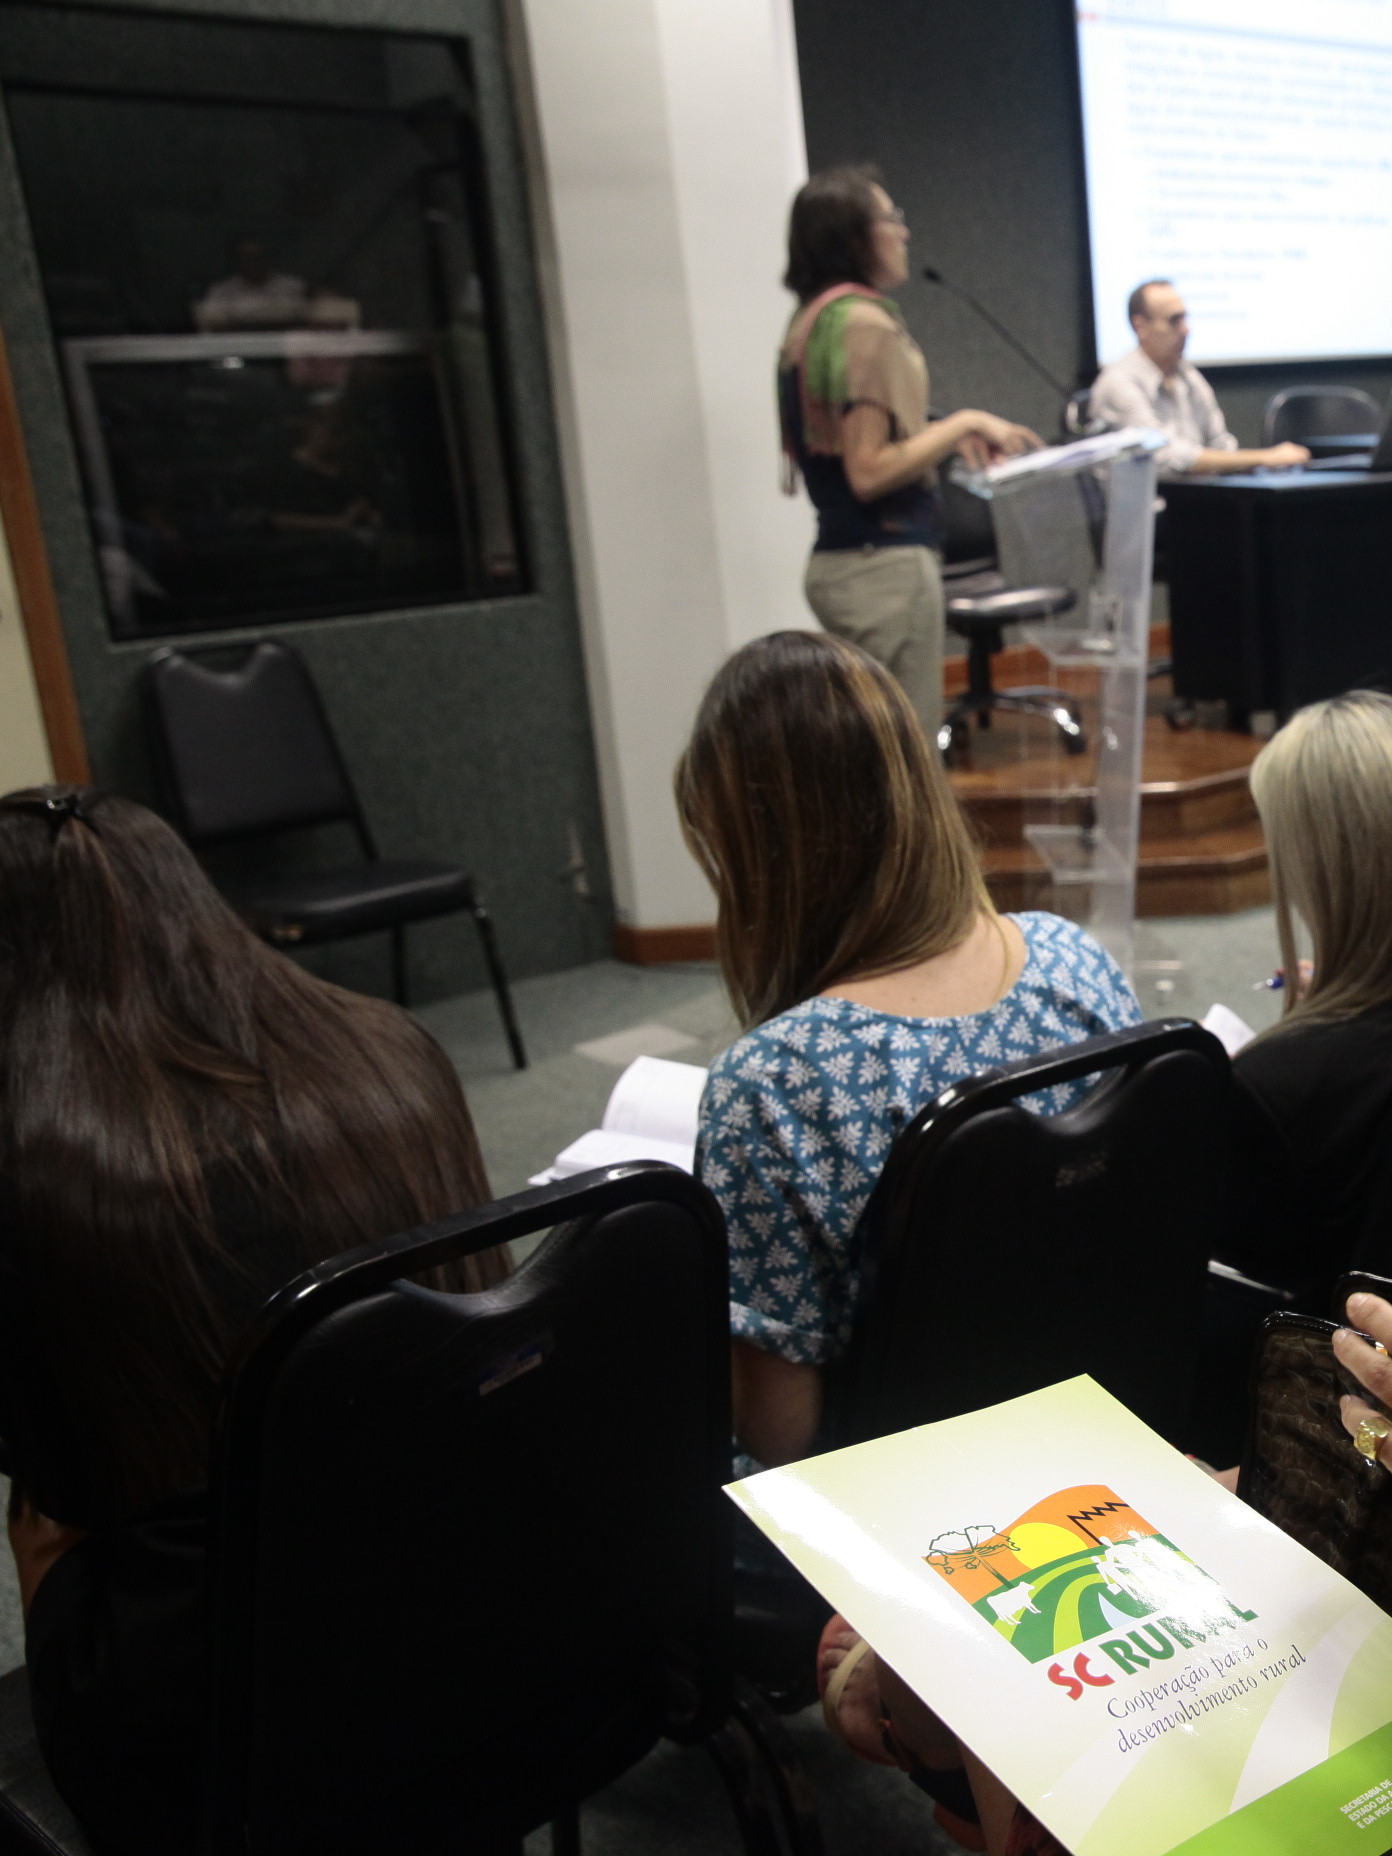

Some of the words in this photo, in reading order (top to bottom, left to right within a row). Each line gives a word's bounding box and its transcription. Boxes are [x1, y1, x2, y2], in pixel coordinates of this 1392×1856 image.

[1047, 1651, 1116, 1701] SC
[1107, 1665, 1210, 1719] Cooperação
[1210, 1643, 1255, 1678] para
[1257, 1638, 1268, 1650] o
[1117, 1674, 1258, 1753] desenvolvimento
[1260, 1644, 1306, 1681] rural
[1340, 1786, 1382, 1814] SECRETARIA
[1380, 1779, 1392, 1789] DE
[1348, 1801, 1377, 1821] ESTADO
[1375, 1794, 1389, 1804] DA
[1357, 1821, 1365, 1829] E
[1362, 1815, 1377, 1825] DA
